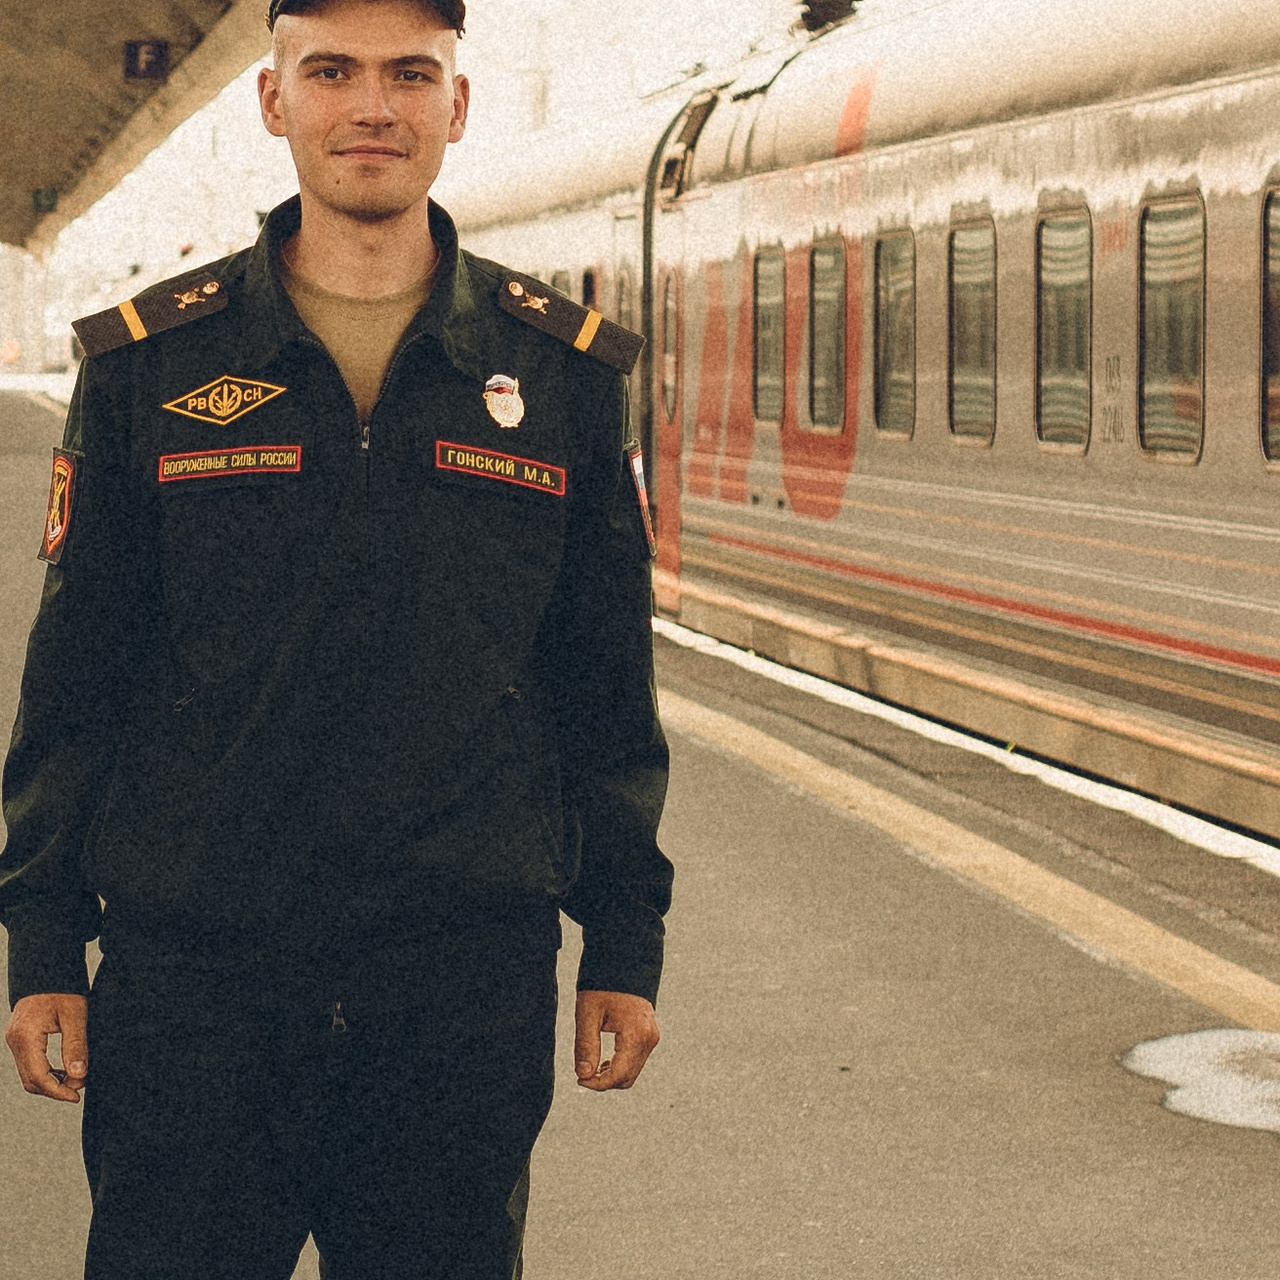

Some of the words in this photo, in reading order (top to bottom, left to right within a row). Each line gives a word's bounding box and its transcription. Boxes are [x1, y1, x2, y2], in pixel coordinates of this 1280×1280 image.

[138, 45, 155, 71] F
[163, 455, 228, 475] ВООРУЖЕННЫЕ
[231, 452, 257, 468] СИЛЫ
[260, 451, 297, 466] РОССИИ
[447, 450, 515, 476] ГОНСКИЙ
[524, 465, 556, 487] М.А.
